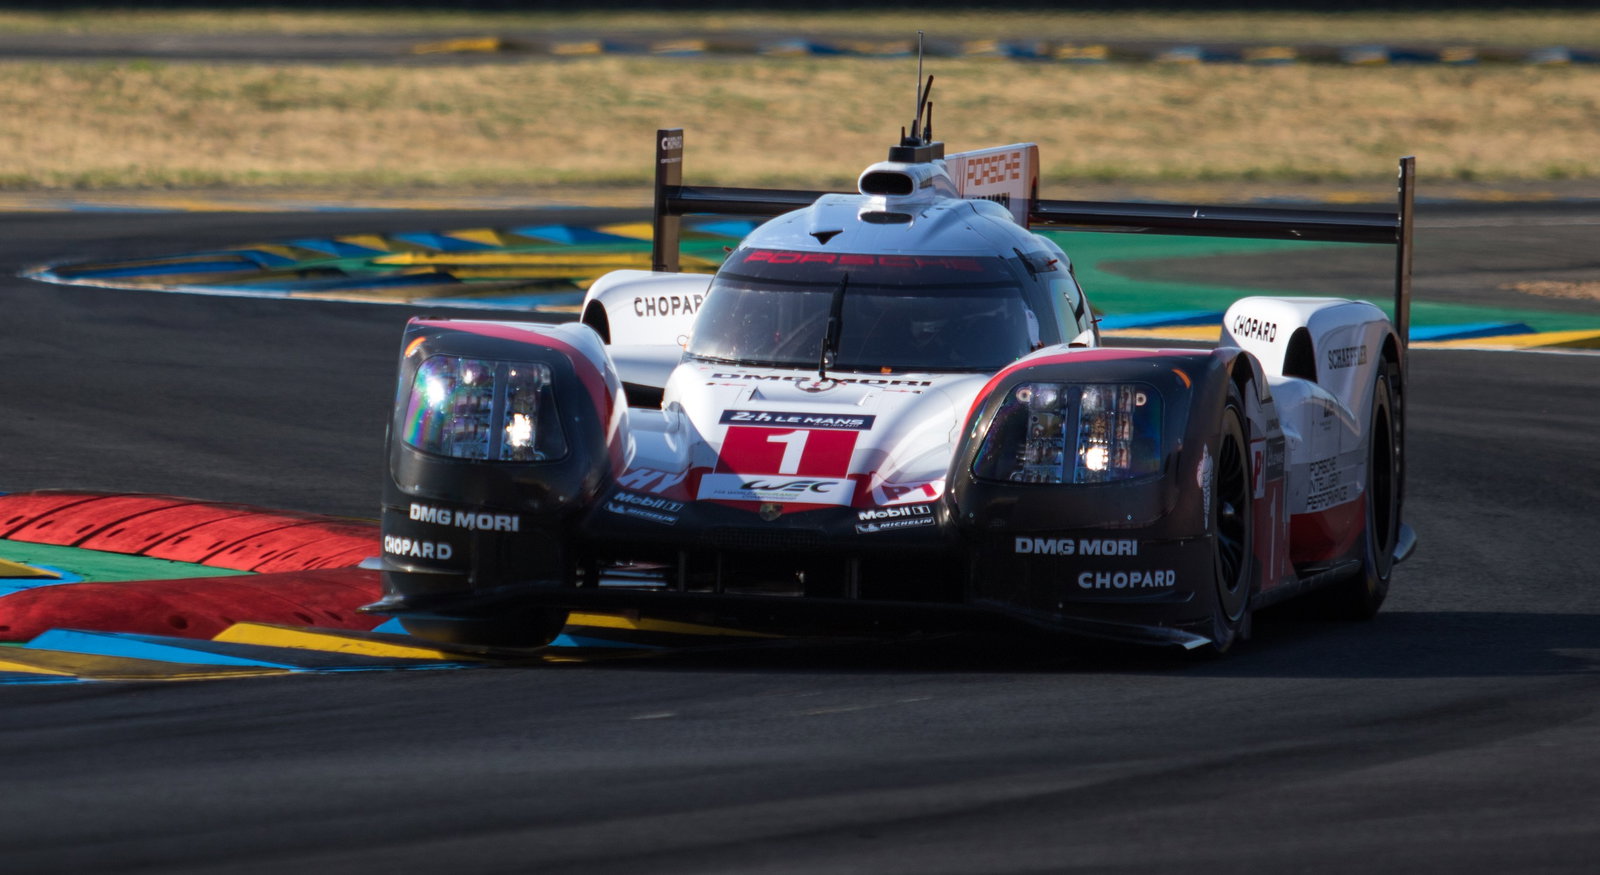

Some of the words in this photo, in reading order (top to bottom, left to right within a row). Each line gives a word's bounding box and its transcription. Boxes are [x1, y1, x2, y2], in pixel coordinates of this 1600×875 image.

[967, 152, 1020, 186] PORSCHE
[744, 250, 984, 272] PORSCHE
[1234, 314, 1277, 343] CHOPARD
[711, 373, 811, 382] DMG
[822, 377, 932, 386] MORI
[775, 415, 801, 423] LE
[803, 417, 864, 426] MANS
[766, 430, 810, 475] 1
[617, 468, 688, 493] HY
[740, 479, 839, 494] WEC
[614, 491, 665, 508] Mobil
[410, 503, 451, 526] DMG
[454, 511, 519, 532] MORI
[858, 506, 911, 521] Mobil
[880, 518, 932, 529] MICHELIN
[384, 534, 453, 560] CHOPARD
[1015, 537, 1075, 555] DMG
[1079, 539, 1138, 556] MORI
[1078, 570, 1176, 589] CHOPARD
